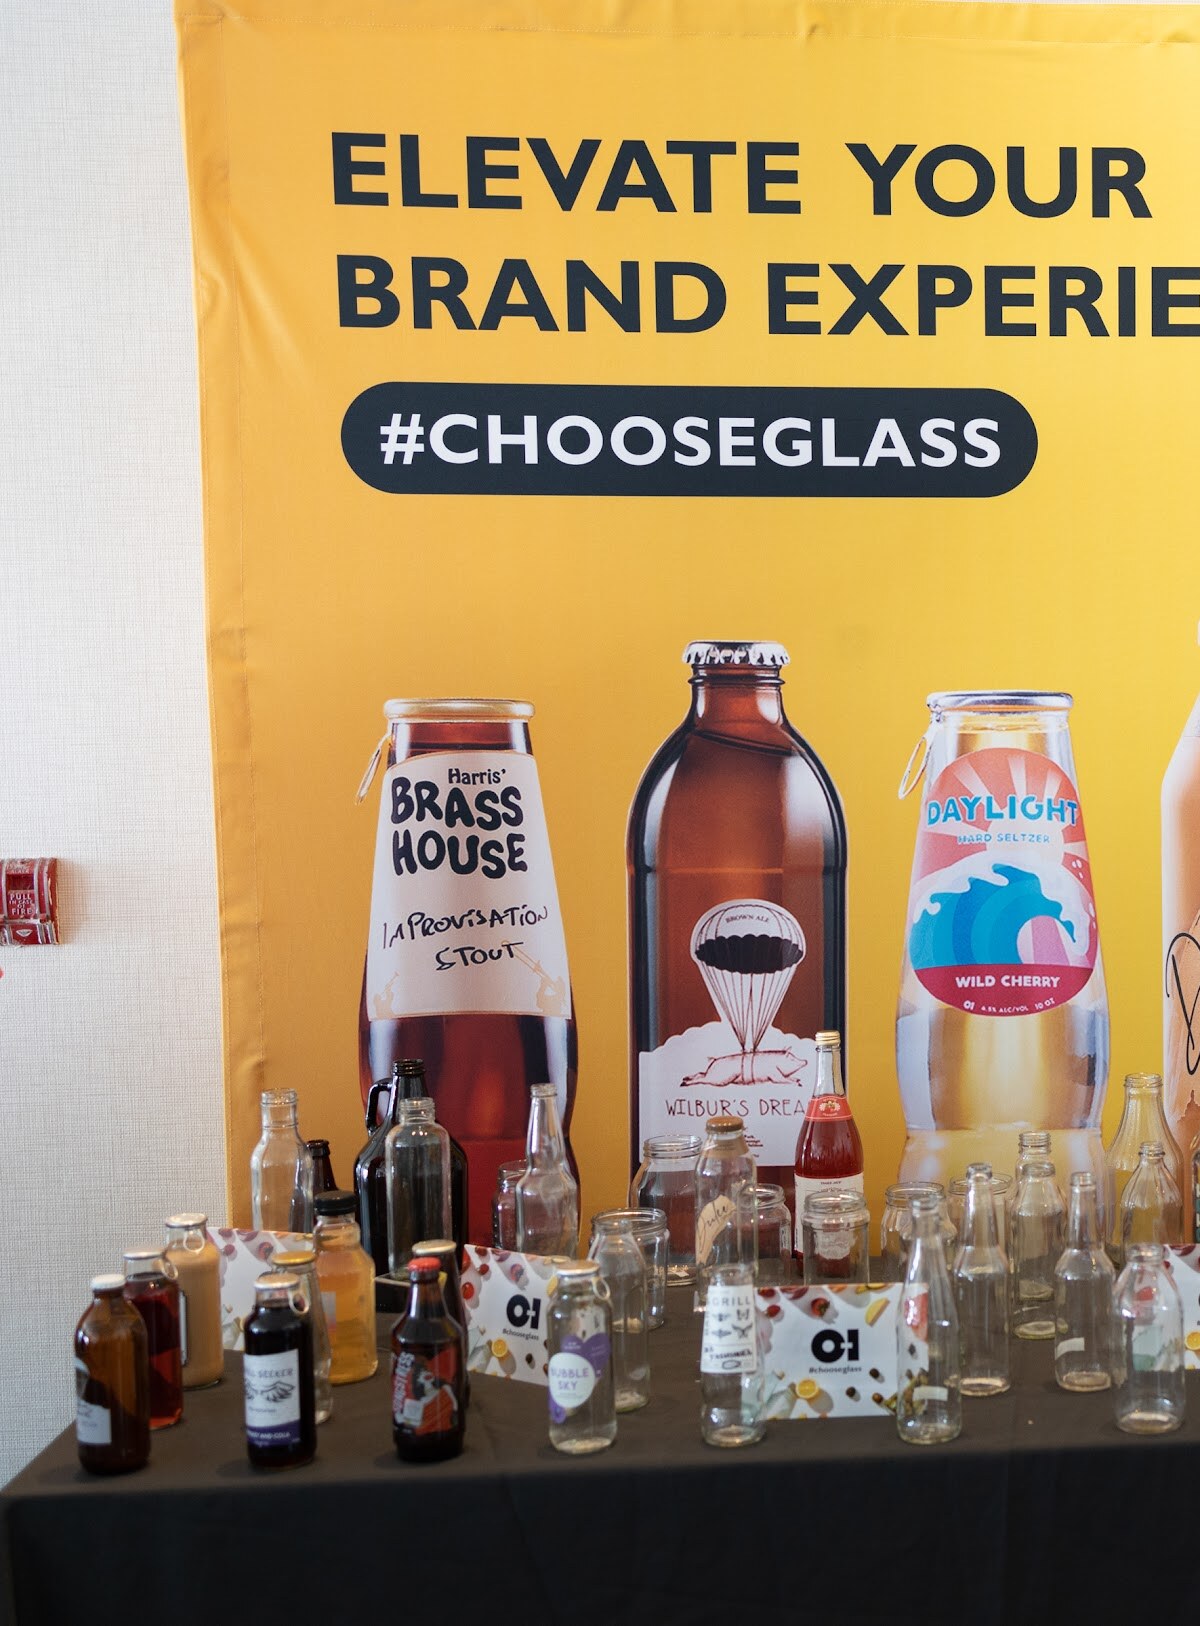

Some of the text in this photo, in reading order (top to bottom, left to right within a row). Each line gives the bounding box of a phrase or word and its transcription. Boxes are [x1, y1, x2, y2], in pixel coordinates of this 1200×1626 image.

[331, 132, 1153, 218] ELEVATE YOUR
[336, 254, 727, 333] BRAND
[380, 413, 1001, 468] #CHOOSEGLASS
[391, 777, 524, 831] BRASS
[927, 795, 1078, 826] DAYLIGHT
[957, 833, 1050, 843] HARD SELTZER
[392, 829, 528, 879] HOUSE
[725, 914, 770, 923] BROWN ALE
[435, 942, 524, 971] STOUT
[955, 974, 1061, 988] WILD CHERRY
[665, 1098, 805, 1117] WILBUR'S DREA
[502, 1328, 539, 1341] #chooseglass
[808, 1365, 862, 1375] #chooseglass
